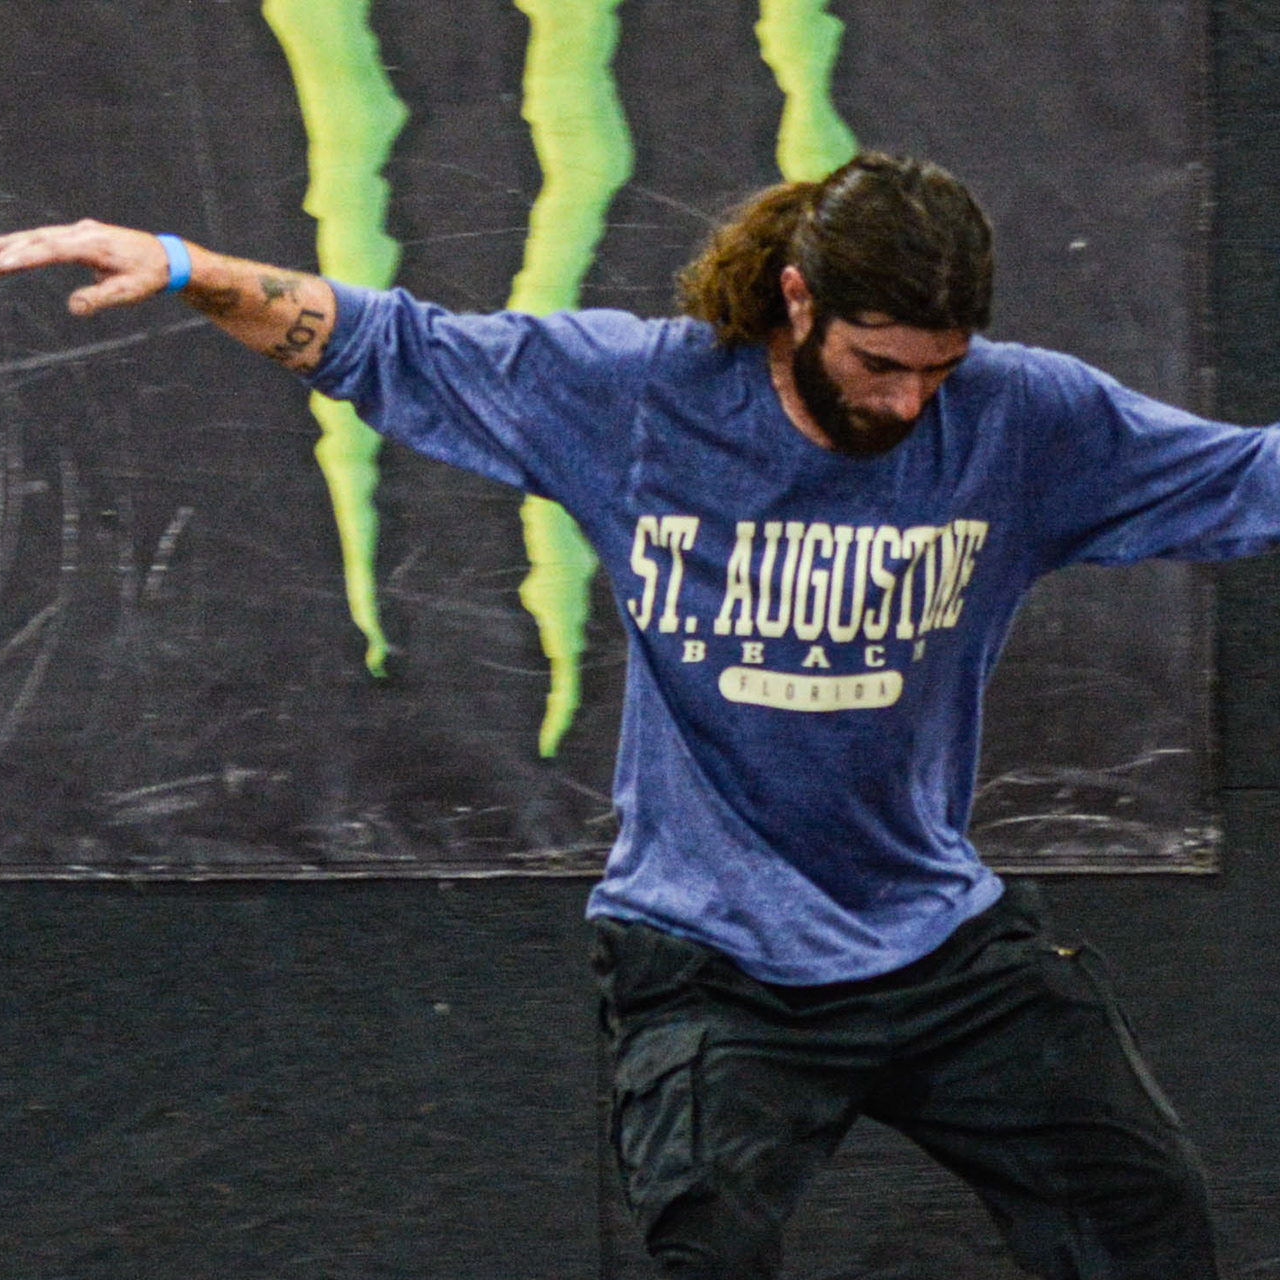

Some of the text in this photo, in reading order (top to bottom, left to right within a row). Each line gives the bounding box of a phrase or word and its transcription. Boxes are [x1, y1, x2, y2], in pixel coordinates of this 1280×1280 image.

[627, 515, 989, 643] ST. AUGUSTINE
[738, 674, 887, 702] FLORIDA
